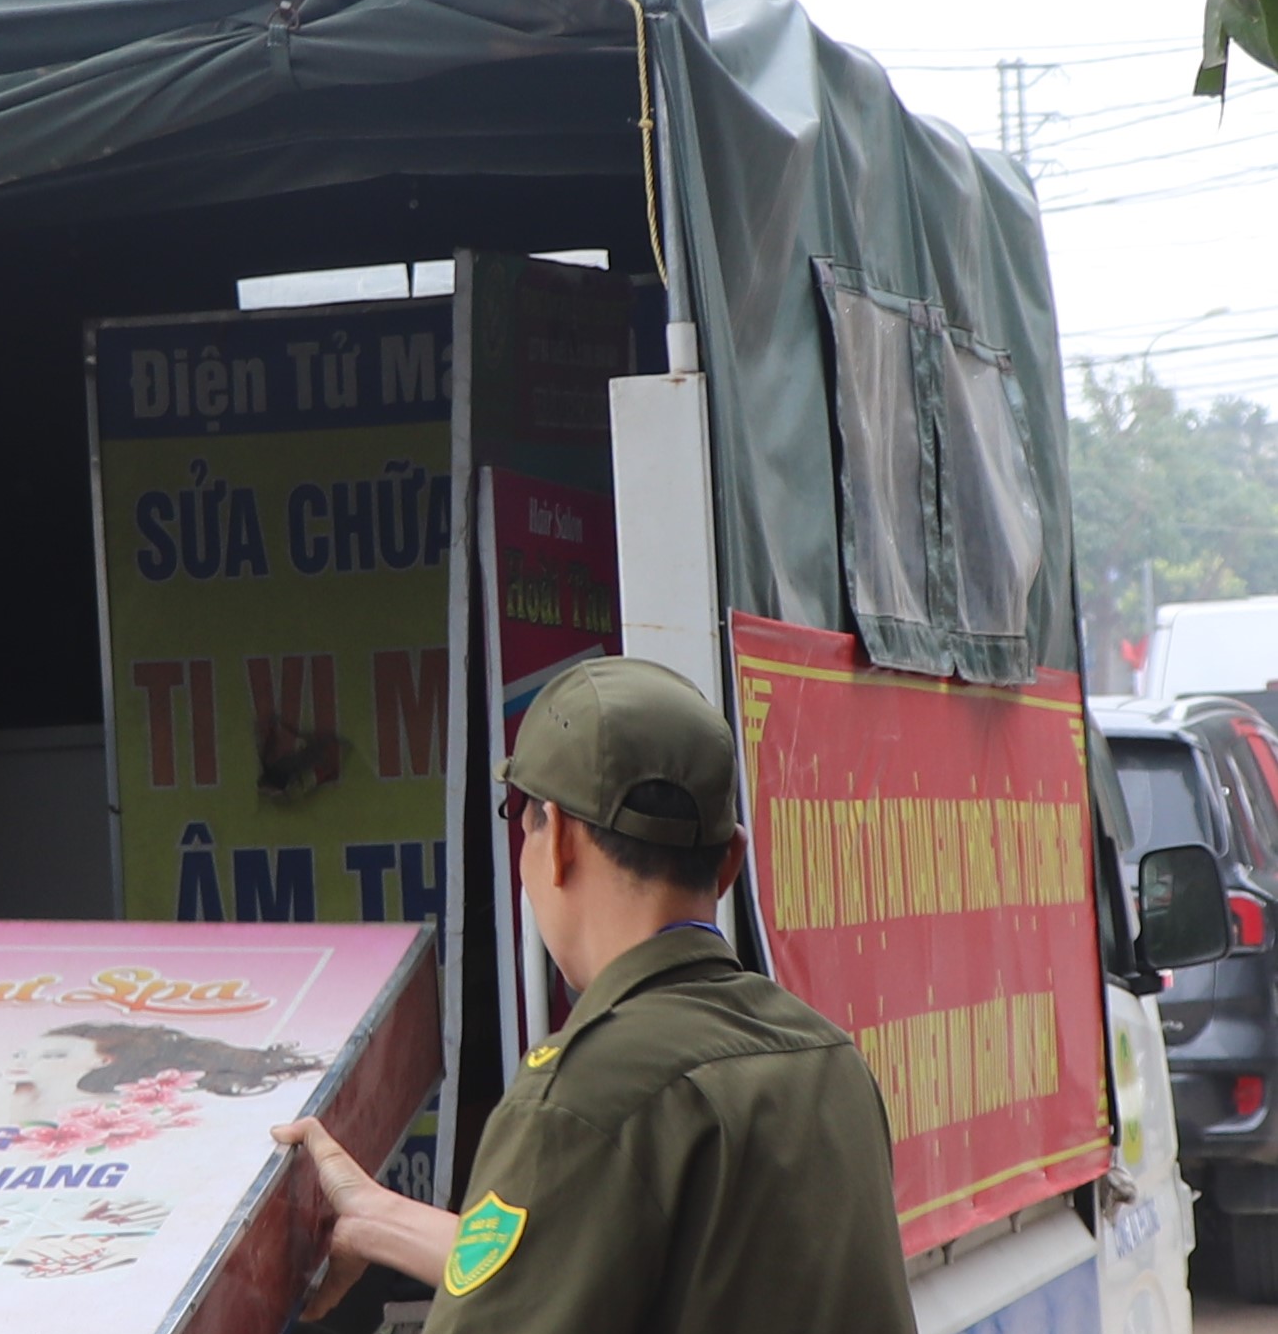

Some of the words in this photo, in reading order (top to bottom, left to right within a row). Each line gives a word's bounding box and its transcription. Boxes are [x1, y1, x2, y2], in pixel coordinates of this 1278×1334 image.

[130, 344, 267, 436] Điện
[287, 330, 360, 411] Tử
[136, 458, 269, 582] SỬA
[287, 461, 452, 577] CHỮA
[529, 496, 553, 536] Hair
[134, 658, 218, 789] TI
[247, 653, 340, 784] VI
[177, 821, 316, 923] ÂM
[57, 964, 275, 1015] Spa
